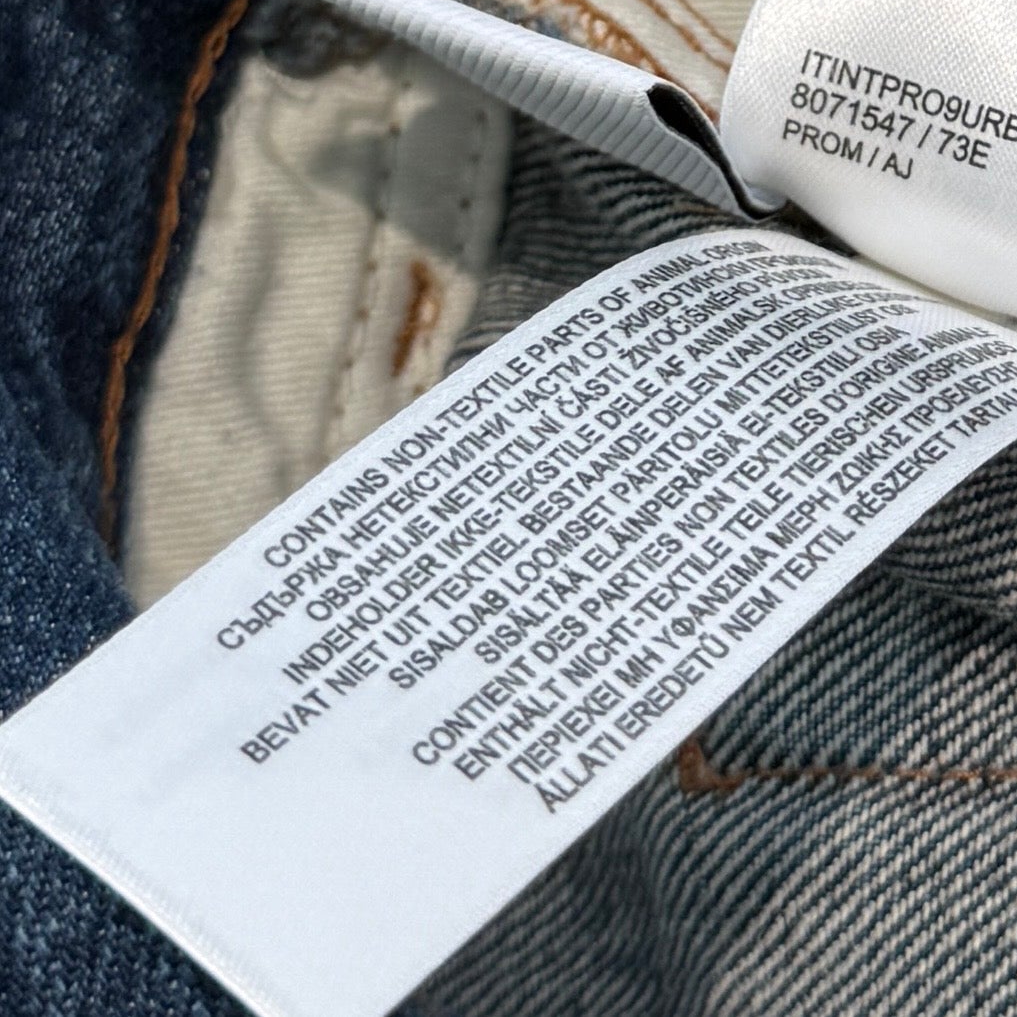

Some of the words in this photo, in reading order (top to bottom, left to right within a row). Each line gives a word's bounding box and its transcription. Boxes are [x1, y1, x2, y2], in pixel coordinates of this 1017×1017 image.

[782, 119, 864, 164] PROM
[867, 145, 880, 168] /
[882, 151, 914, 180] AJ
[791, 84, 915, 138] 8071547
[917, 124, 931, 148] /
[938, 133, 992, 169] 73E
[217, 545, 351, 650] СЪДЪРЖА
[505, 354, 590, 414] ЧАСТИ
[582, 330, 620, 359] ОТ
[611, 261, 751, 338] ЖИВОТИНСКИ
[240, 688, 331, 765] BEVAT
[325, 640, 390, 697] NIET
[382, 604, 432, 648] UIT
[424, 532, 530, 611] TEXTIEL
[517, 421, 659, 535] BESTAANDE
[648, 365, 729, 429] DELEN
[718, 333, 772, 372] VAN
[264, 471, 387, 568] CONTAINS
[382, 356, 535, 474] NON-TEXTILE
[525, 308, 604, 363] PARTS
[598, 287, 631, 312] OF
[630, 253, 710, 293] ANIMAL
[702, 240, 772, 263] ORIGIN
[282, 553, 447, 685] INDEHOLDER
[435, 423, 604, 560] IKKE-TEKSTILE
[594, 377, 663, 430] DELE
[655, 354, 686, 383] AF
[684, 293, 786, 362] ANIMALSK
[305, 515, 440, 621] OBSAHUJE
[429, 409, 565, 521] NETEXTILNÍ
[555, 362, 630, 419] ČÁSTI
[617, 280, 760, 371] ŽIVOČIŠNÉHO
[389, 588, 510, 689] SISALDAB
[500, 496, 617, 594] LOOMSET
[610, 408, 723, 503] PÄRITOLU
[412, 655, 537, 766] CONTIENT
[530, 615, 589, 665] DES
[579, 533, 683, 621] PARTIES
[674, 486, 736, 540] NON
[722, 407, 829, 485] TEXTILES
[819, 343, 928, 413] D'ORIGINE
[453, 679, 568, 780] ENTHÄLT
[559, 535, 733, 686] NICHT-TEXTILE
[719, 482, 794, 542] TEILE
[780, 387, 911, 481] TIERISCHEN
[903, 340, 1017, 394] URSPRUNGS
[474, 562, 592, 664] SISÄLTÄÄ
[581, 429, 750, 573] ELÄINPERÄISIÄ
[739, 345, 863, 437] EI-TEKSTIILI
[855, 325, 911, 352] OSIA
[507, 681, 625, 783] ΠΕΡΙΕΧΕΙ
[614, 645, 665, 688] ΜΗ
[652, 545, 779, 650] ΥΦΑΝΣΙΜΑ
[766, 486, 840, 548] ΜΕΡΗ
[828, 425, 914, 495] ΖΩΙΚΗΣ
[533, 731, 625, 814] ÁLLATI
[721, 586, 783, 641] NEM
[770, 524, 855, 591] TEXTIL
[844, 430, 956, 526] RÉSZEKET
